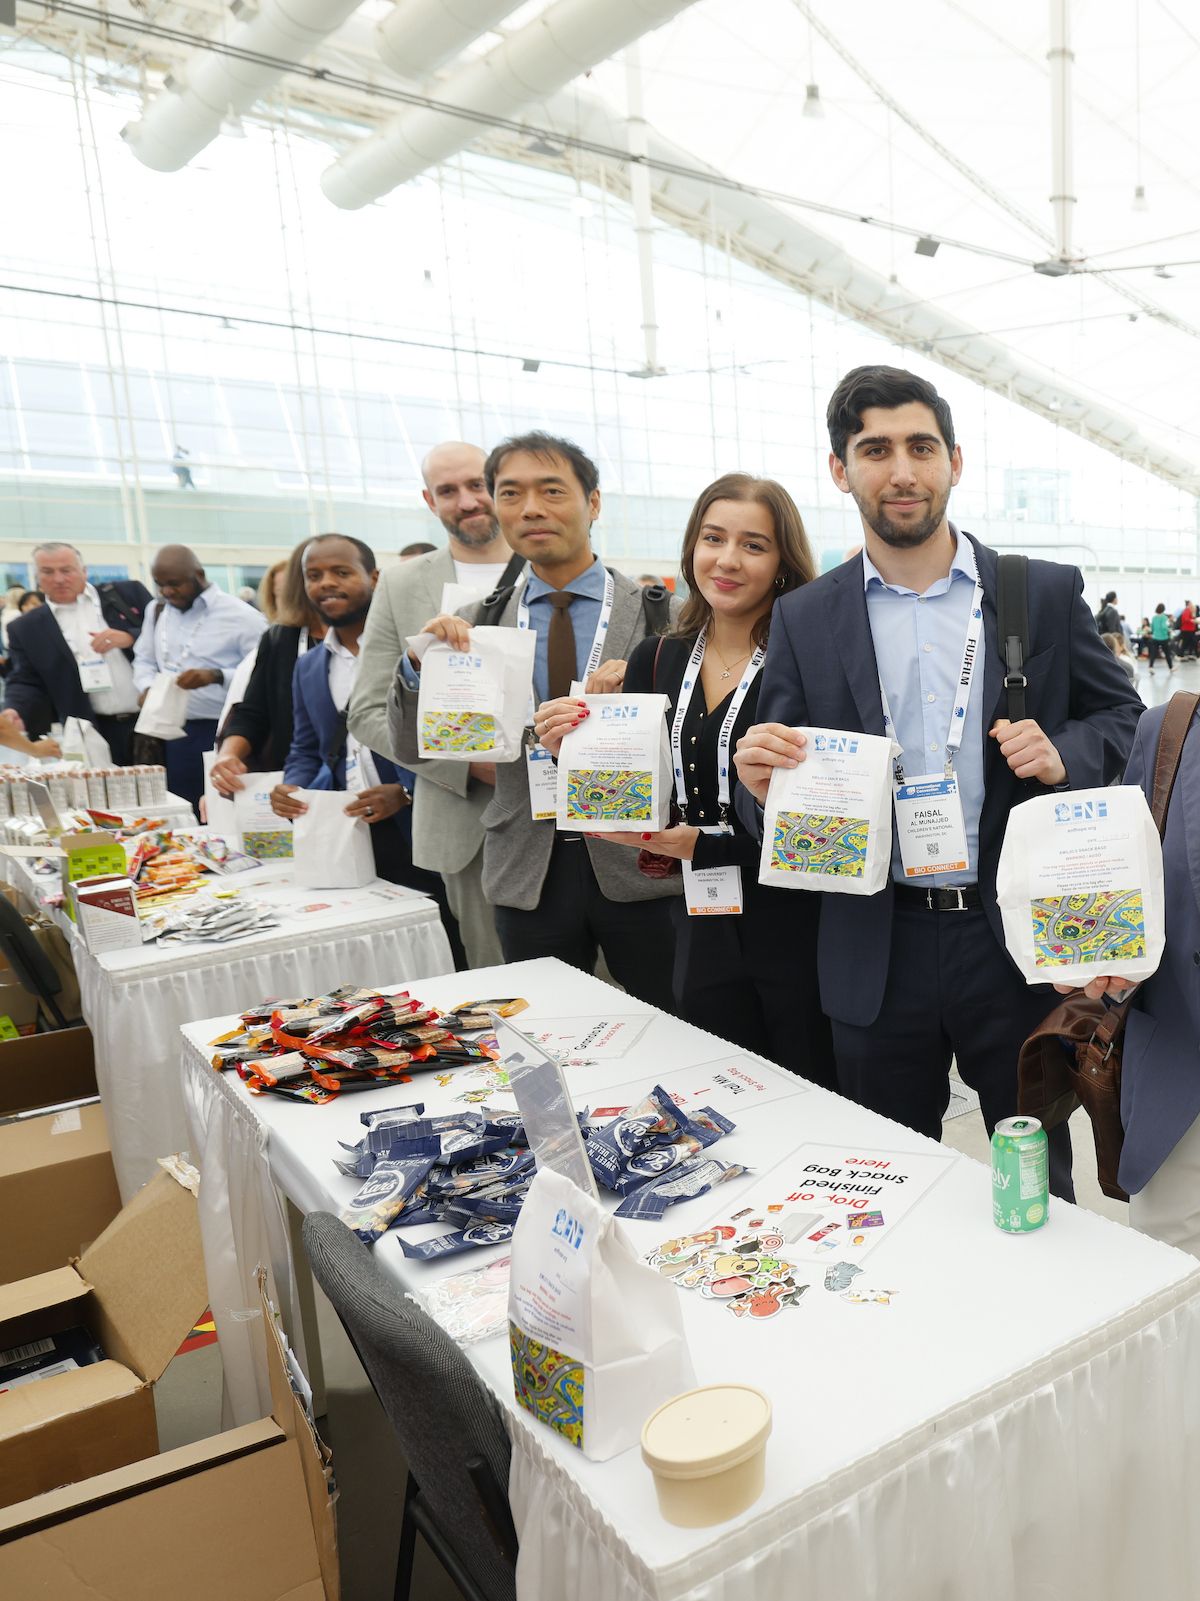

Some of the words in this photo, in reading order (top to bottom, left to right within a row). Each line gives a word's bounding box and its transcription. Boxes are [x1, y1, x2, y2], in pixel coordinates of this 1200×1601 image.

[960, 638, 977, 686] FUJIFILM
[673, 708, 685, 749] FUJIFILM
[720, 707, 738, 748] FUJIFILM
[914, 809, 943, 818] FAISAL
[927, 863, 959, 872] CONNECT
[711, 1073, 729, 1085] Mix
[303, 1086, 328, 1099] KIND
[723, 1082, 746, 1095] Trail
[587, 1140, 610, 1157] DELUXE
[595, 1156, 617, 1172] SWEET
[845, 1157, 891, 1169] Here
[802, 1164, 842, 1177] Bag
[846, 1170, 909, 1184] Snack
[799, 1179, 883, 1195] Finished
[784, 1192, 815, 1202] off
